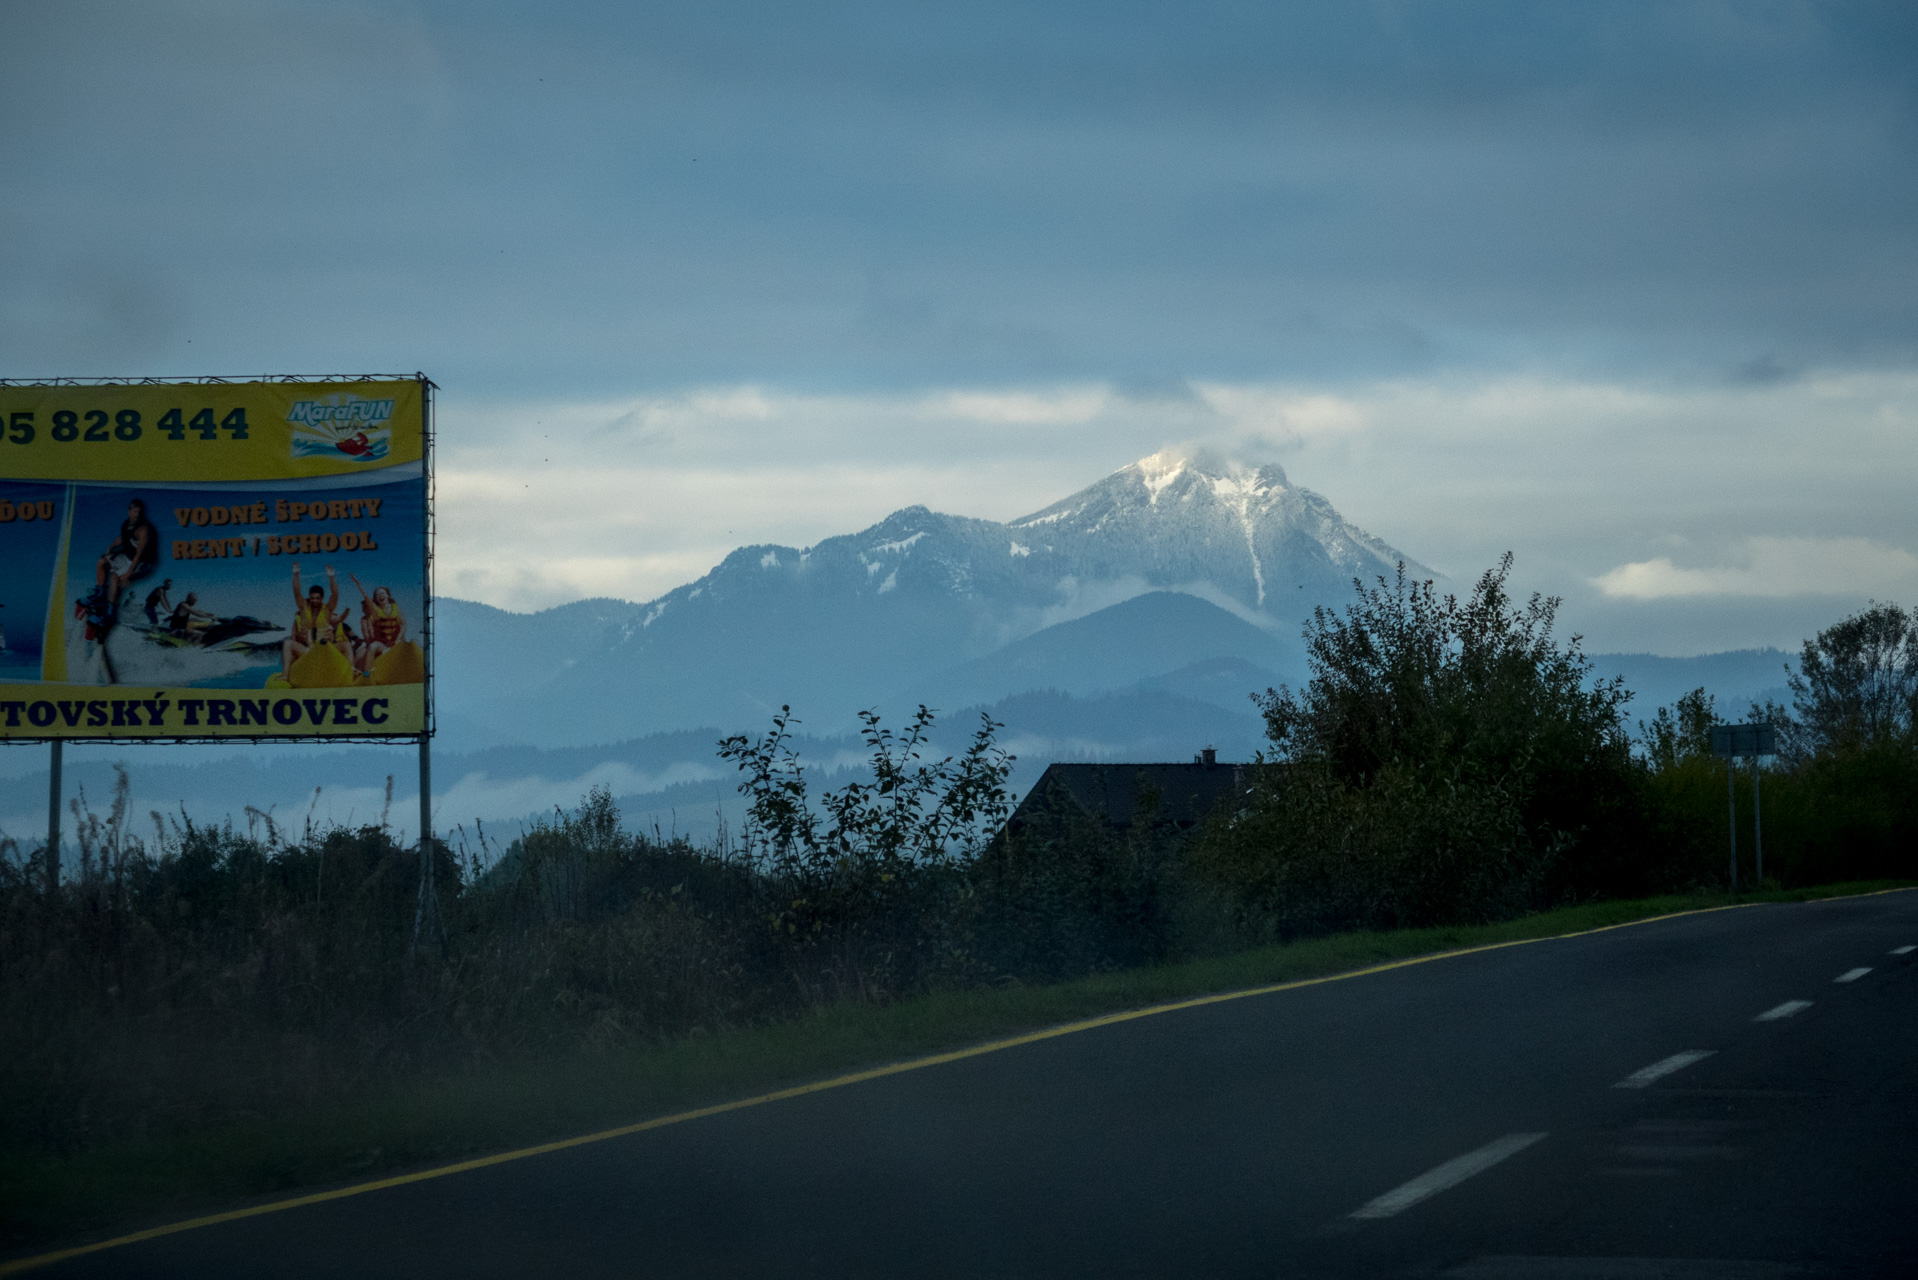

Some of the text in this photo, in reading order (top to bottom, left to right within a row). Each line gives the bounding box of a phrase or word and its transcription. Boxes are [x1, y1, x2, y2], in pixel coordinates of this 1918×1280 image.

[0, 407, 249, 445] 5 828 444
[286, 399, 395, 427] MaraFUN
[174, 498, 383, 527] VODNÉ ŠPORTY
[171, 538, 246, 559] RENT
[266, 530, 378, 556] SCHOOL
[0, 691, 389, 727] TOVSKÝ TRNOVEC
